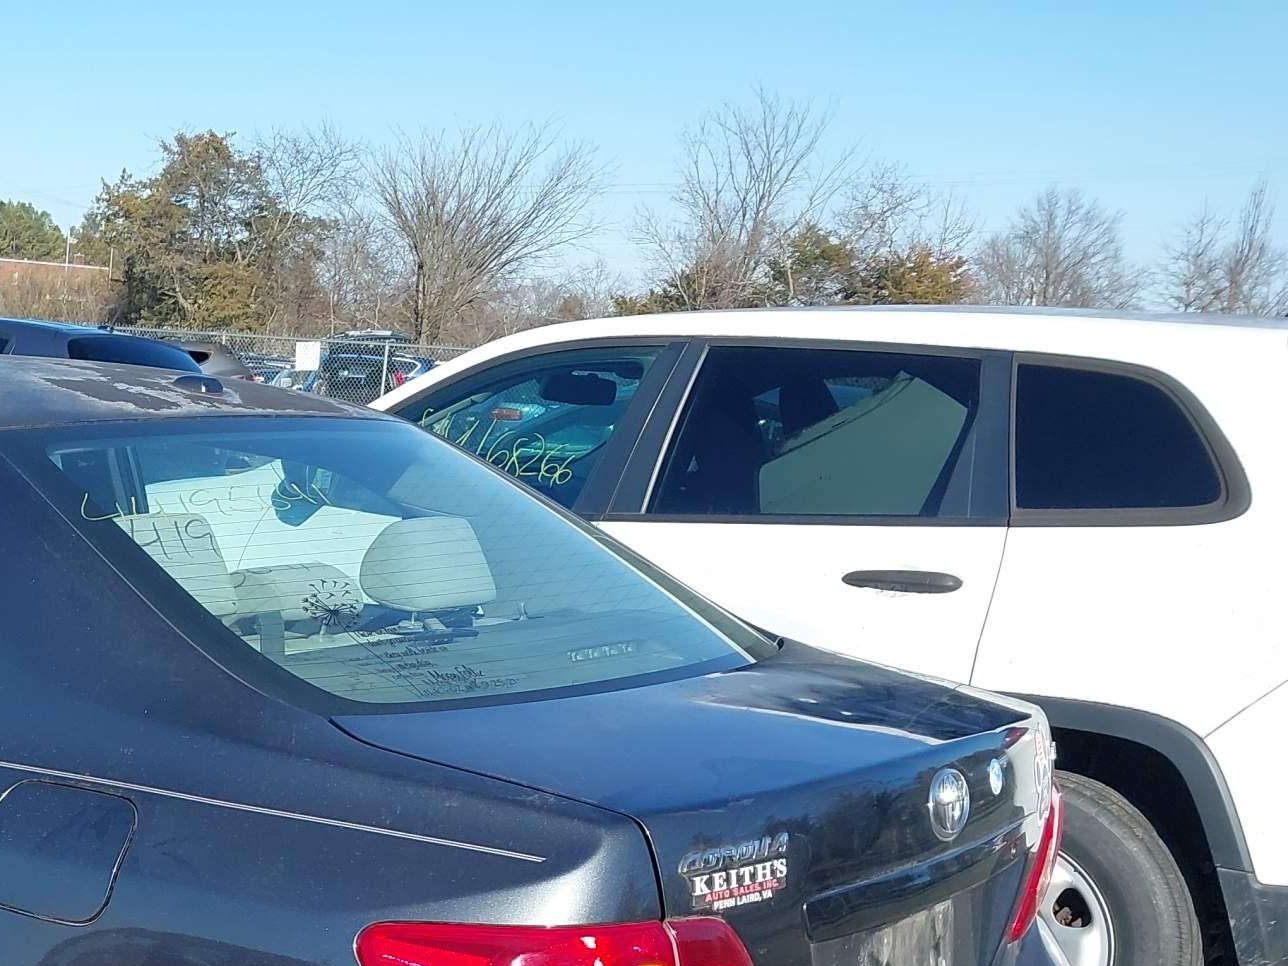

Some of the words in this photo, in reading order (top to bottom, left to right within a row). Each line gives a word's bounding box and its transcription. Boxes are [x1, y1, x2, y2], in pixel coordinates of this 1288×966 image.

[693, 859, 787, 896] KEITH'S
[705, 890, 730, 902] AUTO
[713, 898, 736, 911] PENN
[762, 888, 773, 900] VA
